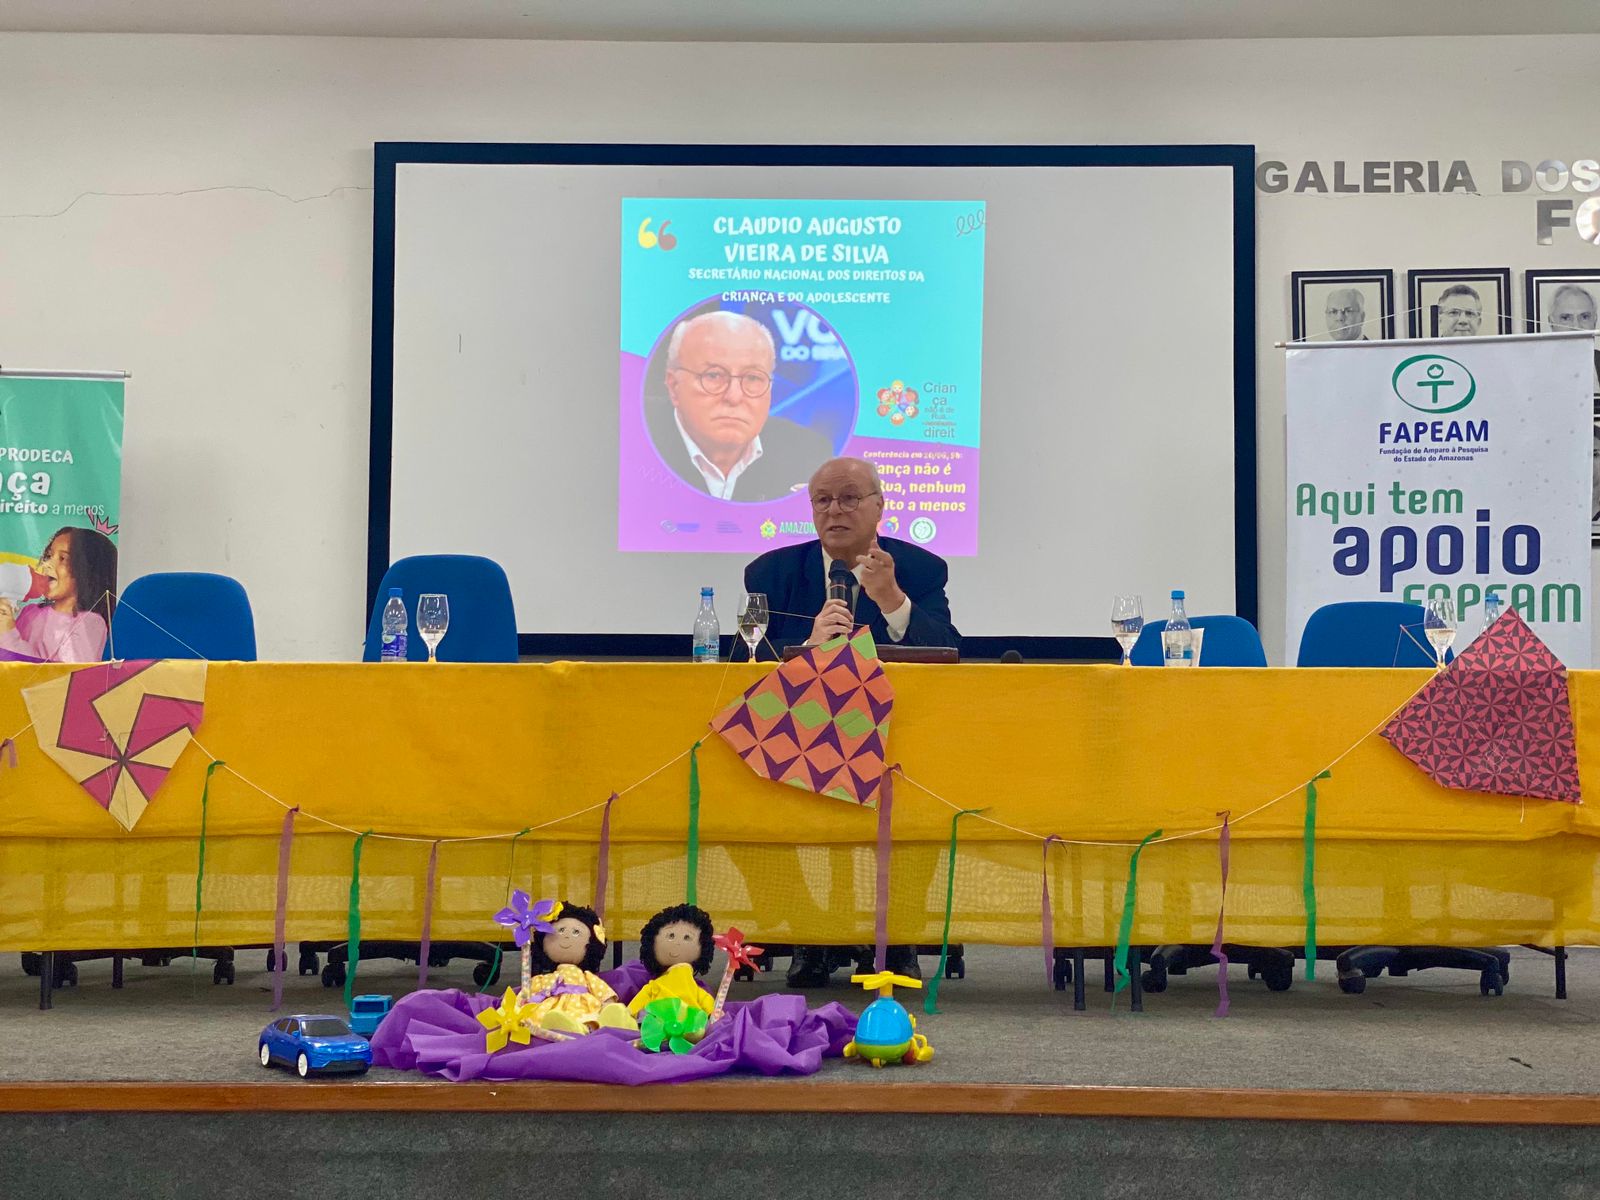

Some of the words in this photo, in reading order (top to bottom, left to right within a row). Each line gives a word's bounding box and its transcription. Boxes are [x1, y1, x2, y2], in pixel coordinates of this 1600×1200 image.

[1256, 160, 1477, 193] GALERIA
[1501, 159, 1600, 193] DOS
[713, 216, 803, 236] CLAUDIO
[806, 215, 902, 237] AUGUSTO
[724, 242, 797, 264] VIEIRA
[800, 244, 828, 262] DE
[832, 243, 890, 265] SILVA
[688, 266, 761, 280] SECRETÁRIO
[763, 268, 825, 281] NACIONAL
[827, 269, 850, 281] DOS
[852, 269, 907, 281] DIREITOS
[908, 270, 925, 282] DA
[721, 290, 775, 305] CRIANÇA
[777, 291, 785, 302] E
[787, 291, 804, 303] DO
[806, 291, 891, 304] ADOLESCENTE
[1379, 419, 1489, 444] FAPEAM
[0, 447, 74, 465] PRODECA
[1379, 447, 1412, 456] Fundação
[1423, 446, 1450, 456] Amparo
[1457, 445, 1489, 455] Pesquisa
[1403, 454, 1427, 463] Estado
[1438, 454, 1474, 462] Amazonas
[875, 462, 911, 478] ança
[914, 463, 940, 476] não
[943, 463, 952, 476] é
[909, 480, 967, 494] nenhum
[0, 499, 49, 514] ireito
[52, 503, 60, 515] a
[63, 504, 105, 516] menos
[907, 501, 917, 512] a
[920, 500, 967, 513] menos
[1296, 483, 1375, 525] Aqui
[1388, 481, 1464, 515] tem
[778, 520, 818, 535] AMAZON
[1332, 508, 1542, 593] apoio
